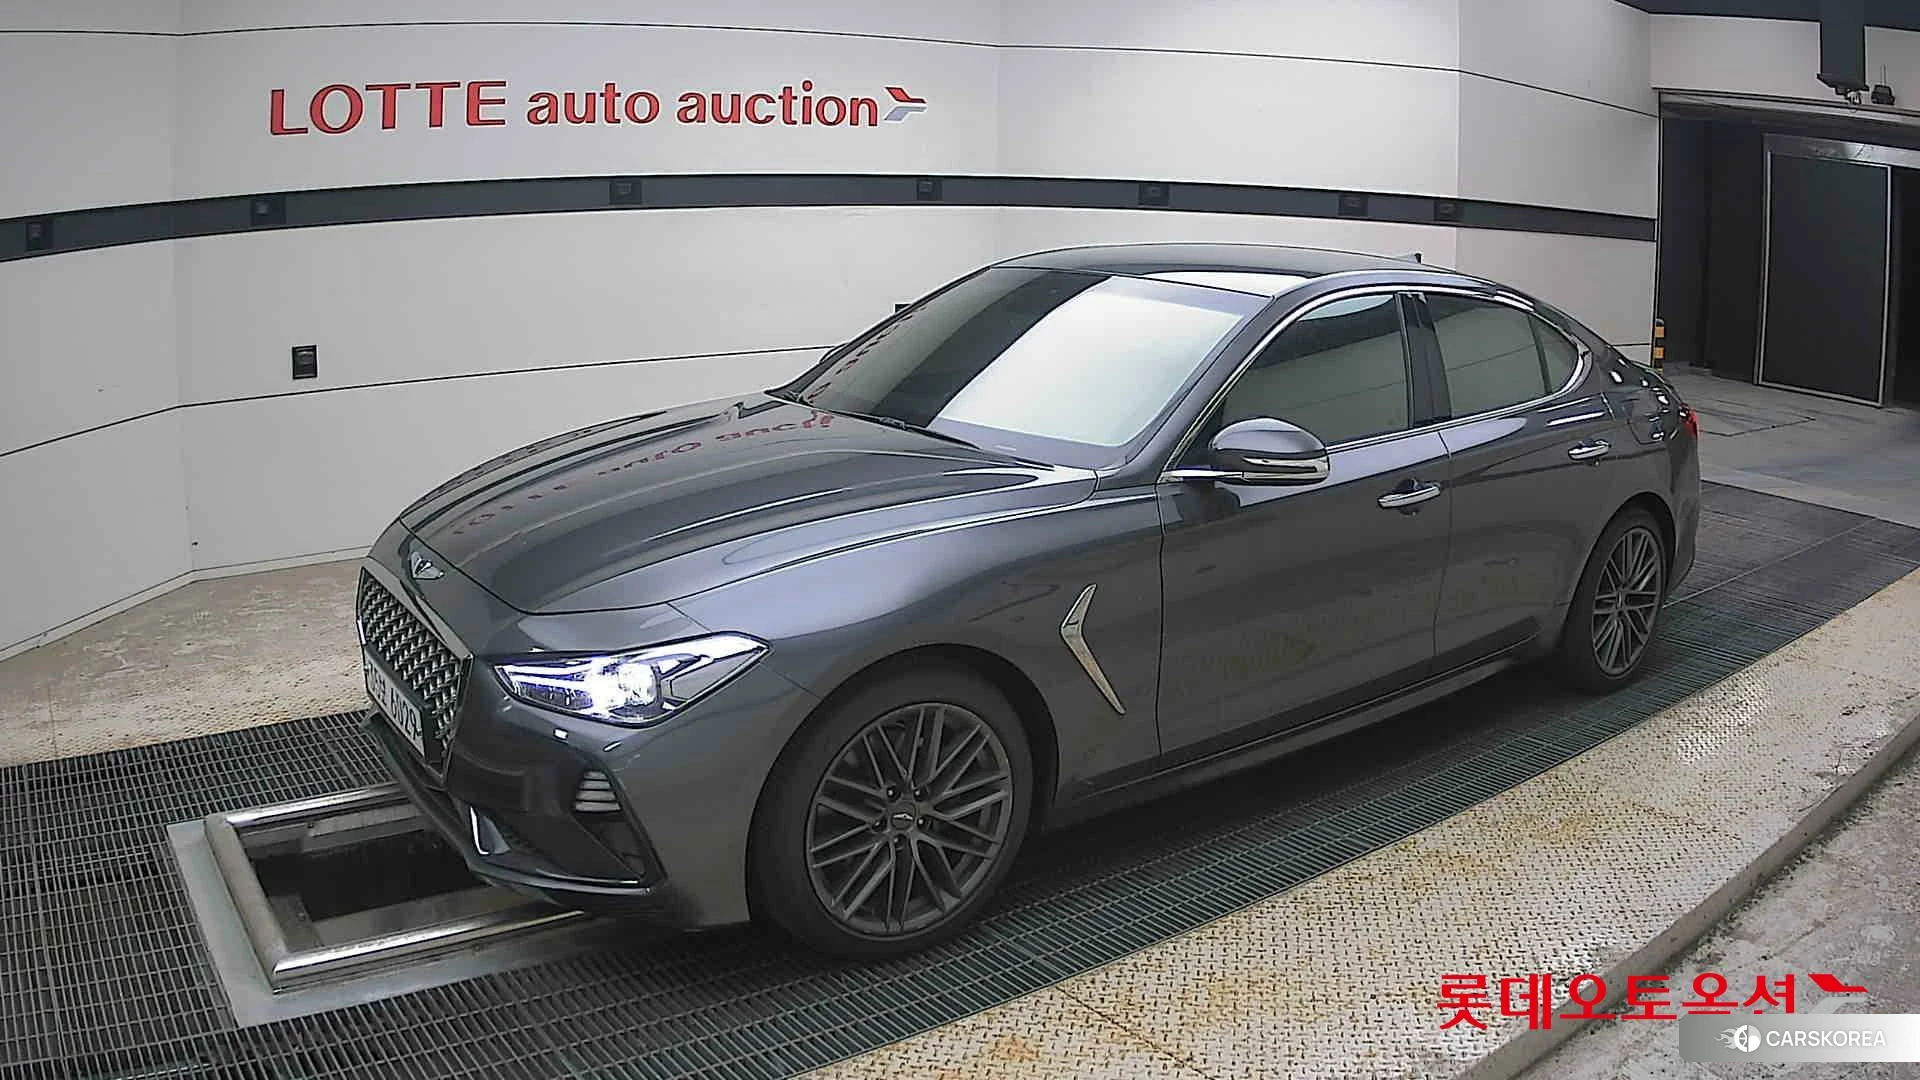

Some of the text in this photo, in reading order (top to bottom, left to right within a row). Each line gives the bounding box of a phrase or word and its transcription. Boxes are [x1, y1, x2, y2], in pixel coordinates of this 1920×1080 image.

[270, 80, 879, 136] LOTTE auto auction
